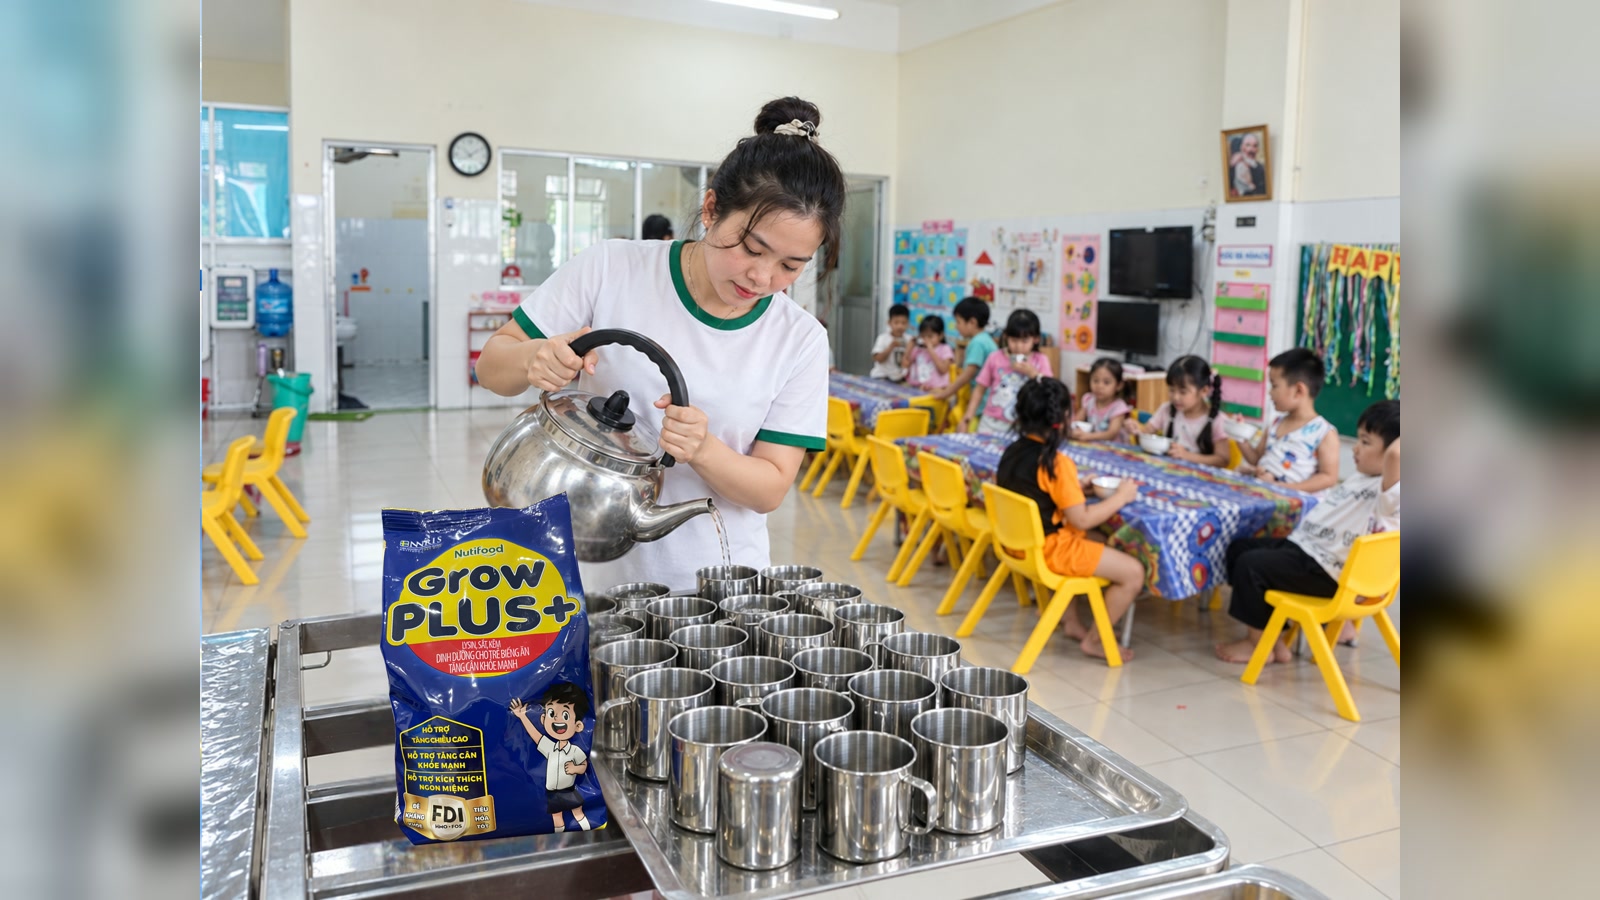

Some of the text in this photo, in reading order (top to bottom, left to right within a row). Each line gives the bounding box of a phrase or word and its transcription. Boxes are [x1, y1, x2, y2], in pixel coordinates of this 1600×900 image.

[454, 544, 504, 559] Nutifood
[391, 595, 577, 642] PLUS+
[461, 641, 478, 650] LYSIN,
[436, 652, 452, 663] DINH
[475, 651, 488, 660] CHO
[501, 647, 519, 659] BIẾNG
[449, 662, 465, 673] TĂNG
[497, 660, 518, 671] MẠNH
[434, 725, 450, 734] TRỢ
[452, 735, 469, 743] CAO
[420, 752, 435, 762] TRỢ
[441, 762, 466, 771] MẠNH
[418, 775, 434, 784] TRỢ
[456, 774, 482, 782] THÍCH
[442, 784, 469, 794] MIỆNG
[432, 804, 464, 823] FDI
